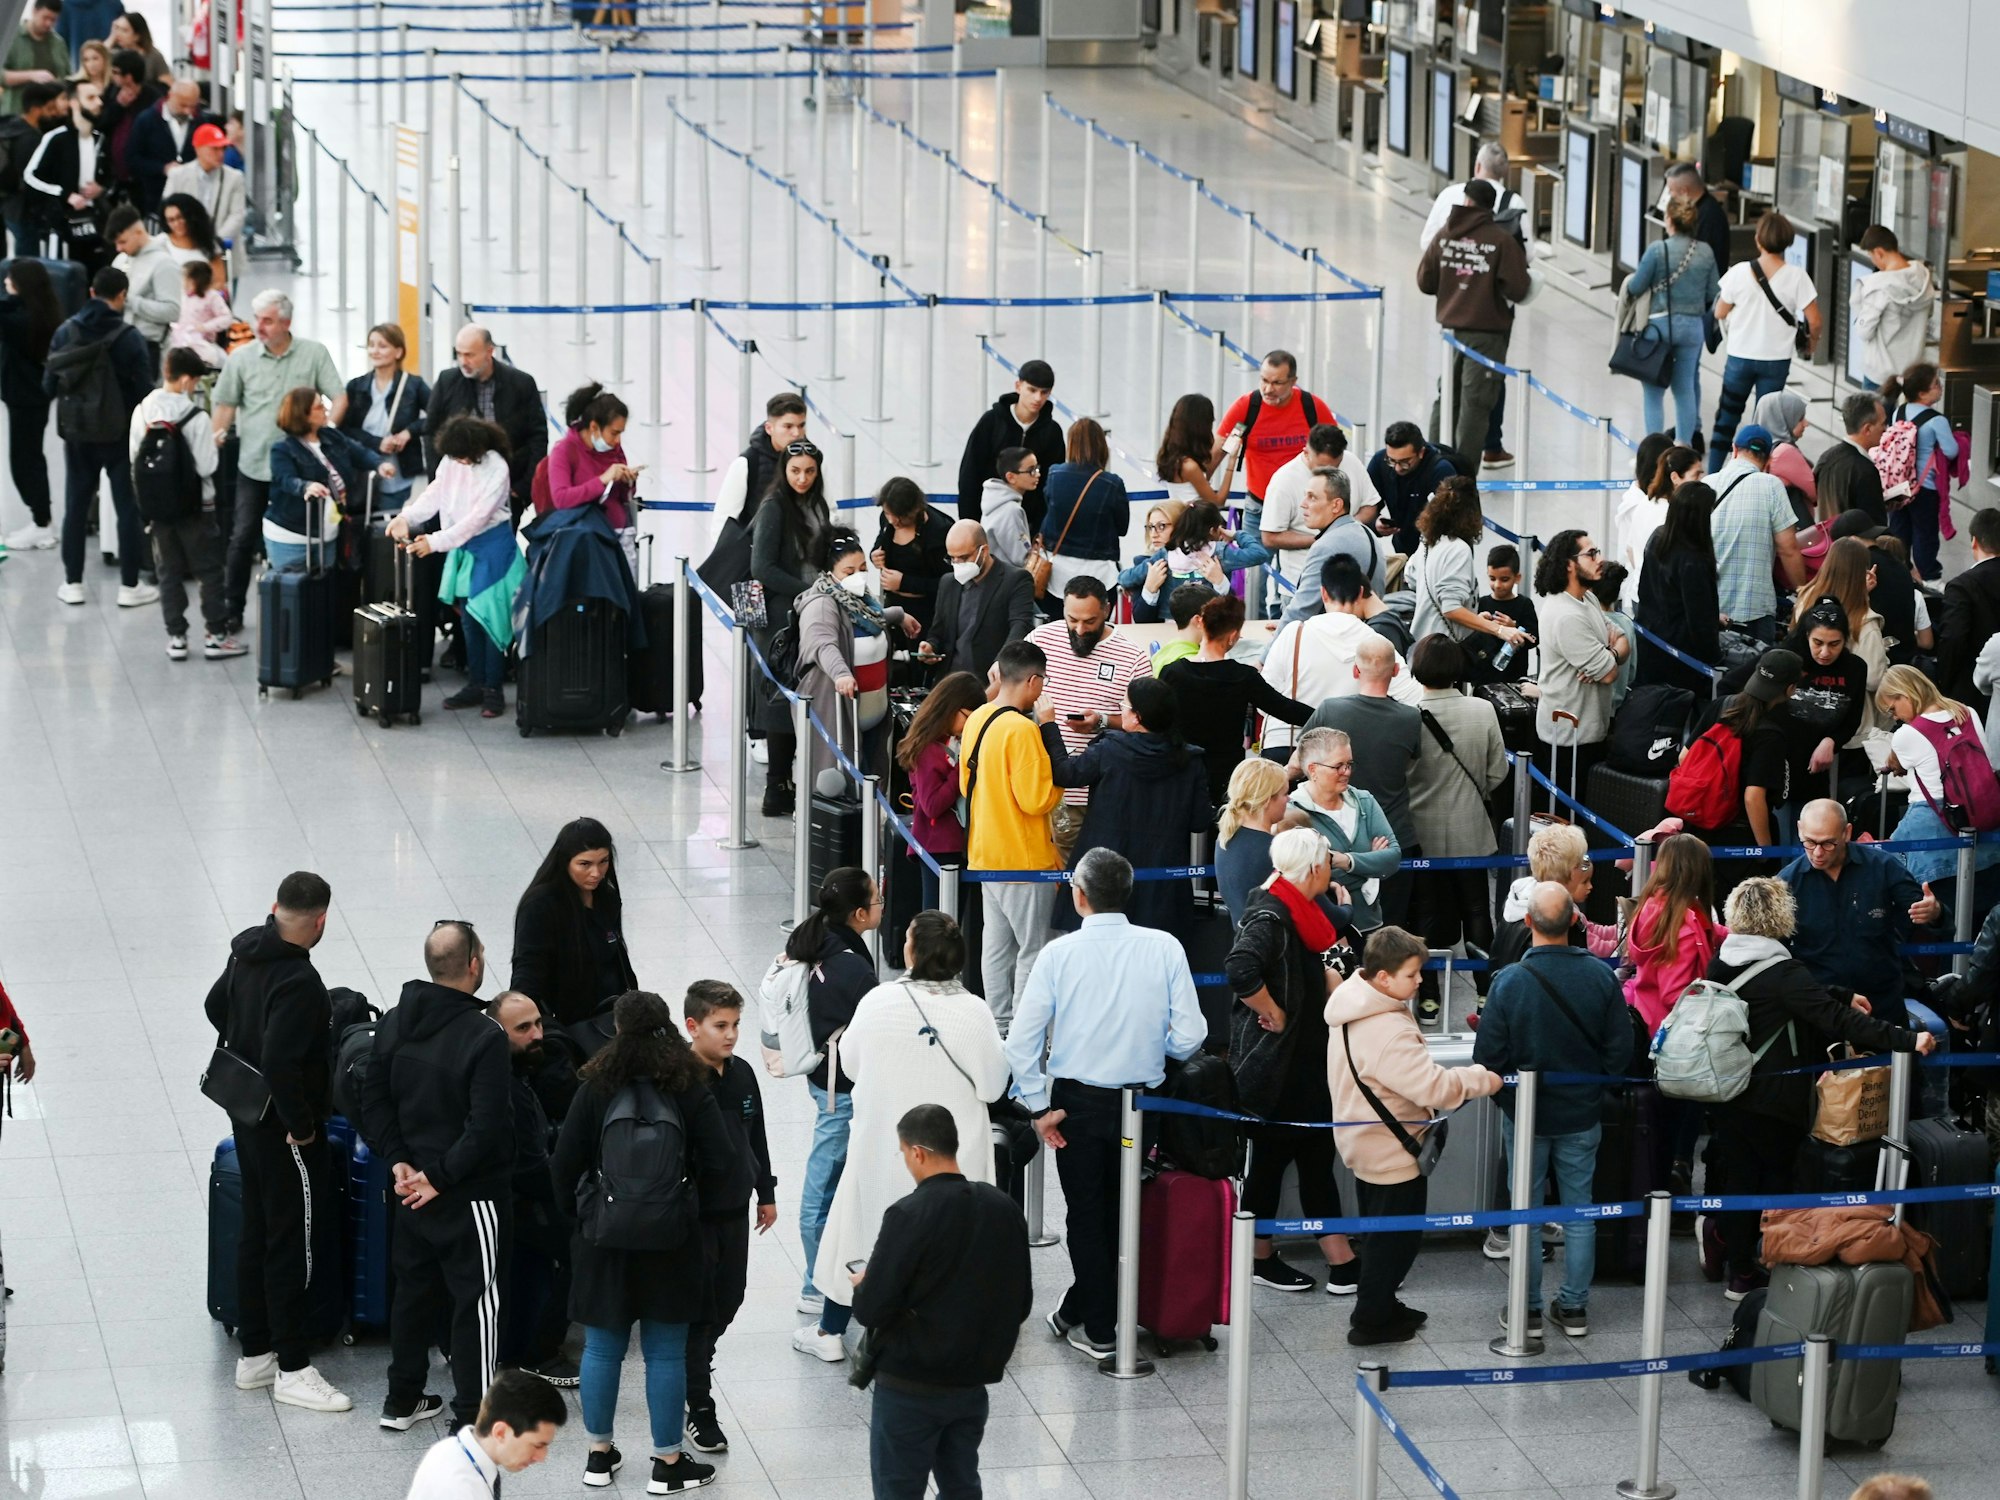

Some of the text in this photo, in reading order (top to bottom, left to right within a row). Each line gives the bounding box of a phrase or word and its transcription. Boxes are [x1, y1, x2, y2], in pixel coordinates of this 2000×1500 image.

[1652, 737, 1672, 751] NIKE
[1745, 847, 1762, 856] DUS
[1412, 860, 1430, 868] DUS
[1062, 871, 1074, 880] DU
[1188, 867, 1205, 876] DUS
[1861, 1081, 1884, 1093] Deine
[1858, 1109, 1877, 1120] Dein
[1702, 1198, 1722, 1208] DUS
[1846, 1194, 1867, 1204] DUS
[1602, 1205, 1622, 1215] DUS
[1302, 1220, 1323, 1231] DUS
[1452, 1215, 1473, 1226] DUS
[1960, 1344, 1982, 1354] DUS
[1646, 1360, 1669, 1371] DUS
[547, 1377, 575, 1385] crocs
[1492, 1371, 1514, 1381] DUS
